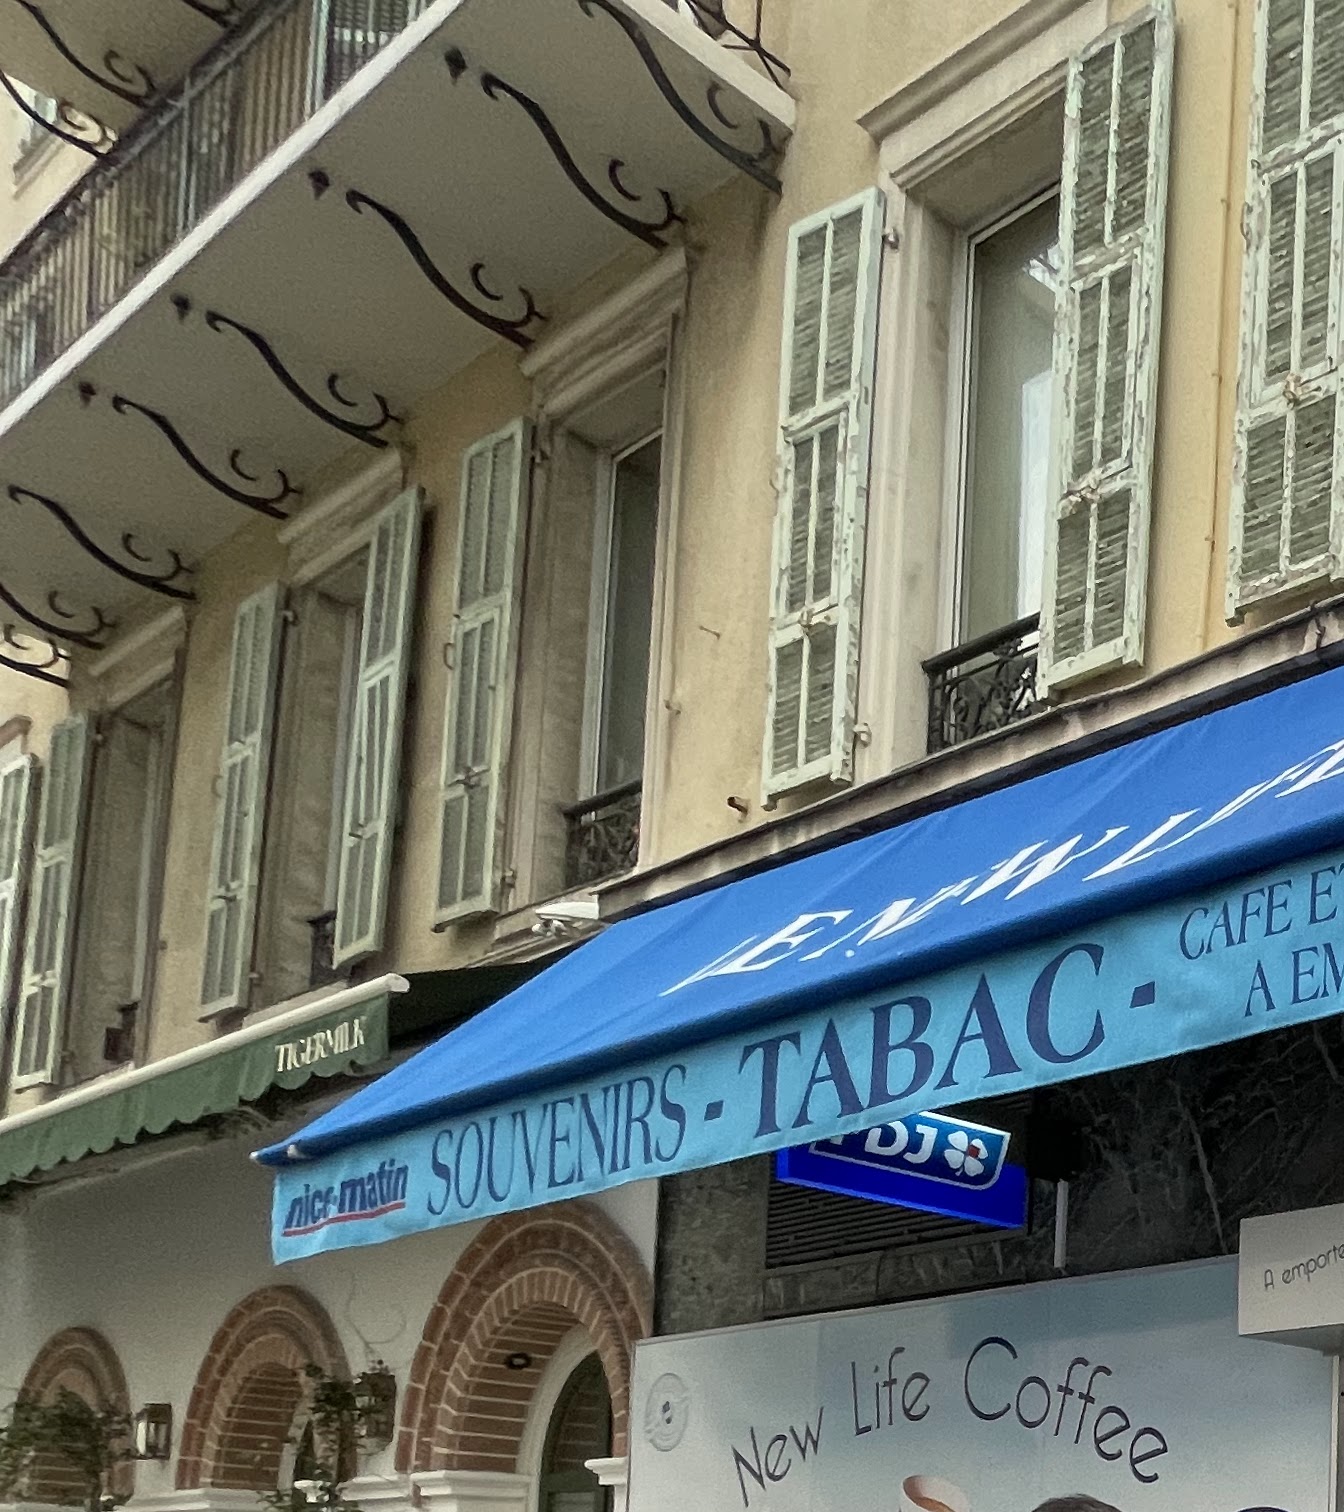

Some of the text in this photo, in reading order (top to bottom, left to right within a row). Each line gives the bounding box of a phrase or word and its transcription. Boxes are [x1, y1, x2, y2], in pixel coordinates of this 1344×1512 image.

[1179, 878, 1292, 960] CAFE
[1243, 958, 1277, 1018] A
[275, 1016, 367, 1073] TIGERMILK
[427, 1064, 687, 1216] SOUVENIRS
[738, 942, 1106, 1139] TABAC
[1263, 1268, 1276, 1291] A
[730, 1404, 825, 1509] New
[850, 1346, 931, 1437] Life
[963, 1335, 1169, 1485] Coffee
